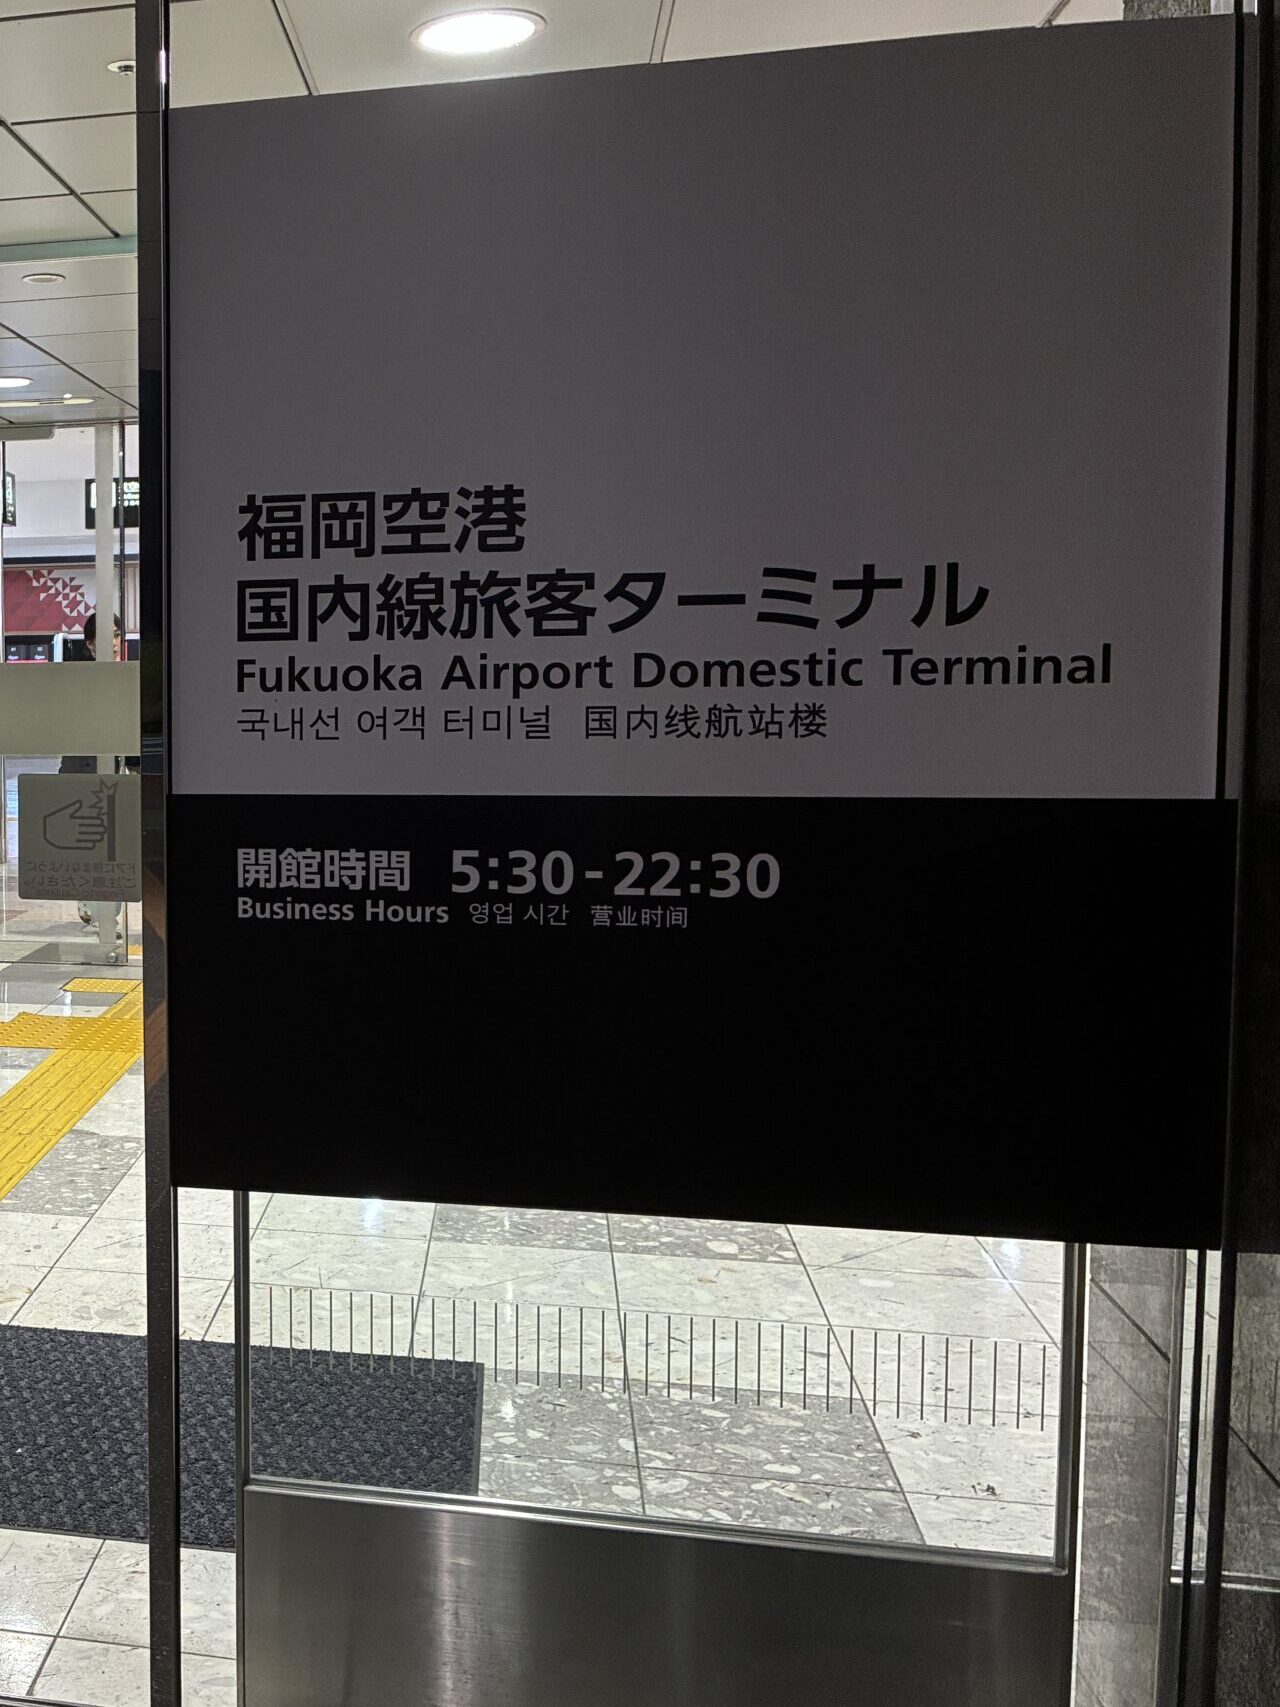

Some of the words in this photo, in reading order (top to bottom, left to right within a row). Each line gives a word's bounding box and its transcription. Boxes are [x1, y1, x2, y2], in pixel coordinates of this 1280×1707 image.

[237, 485, 527, 561] 福岡空港
[237, 562, 990, 643] 国内線旅客ターミナル
[237, 654, 422, 693] Fukuoka
[440, 652, 613, 699] Airport
[633, 647, 863, 688] Domestic
[882, 644, 1112, 685] Terminal
[236, 705, 340, 741] 국내선
[357, 705, 425, 741] 여객
[444, 704, 551, 741] 터미널
[585, 703, 827, 740] 国内线航站楼
[237, 848, 410, 891] 開館時間
[451, 849, 780, 899] 5:30-22:30
[237, 896, 354, 921] Business
[366, 899, 449, 924] Hours
[469, 902, 513, 926] 영업
[523, 903, 569, 927] 시간
[591, 905, 688, 928] 营业时间
